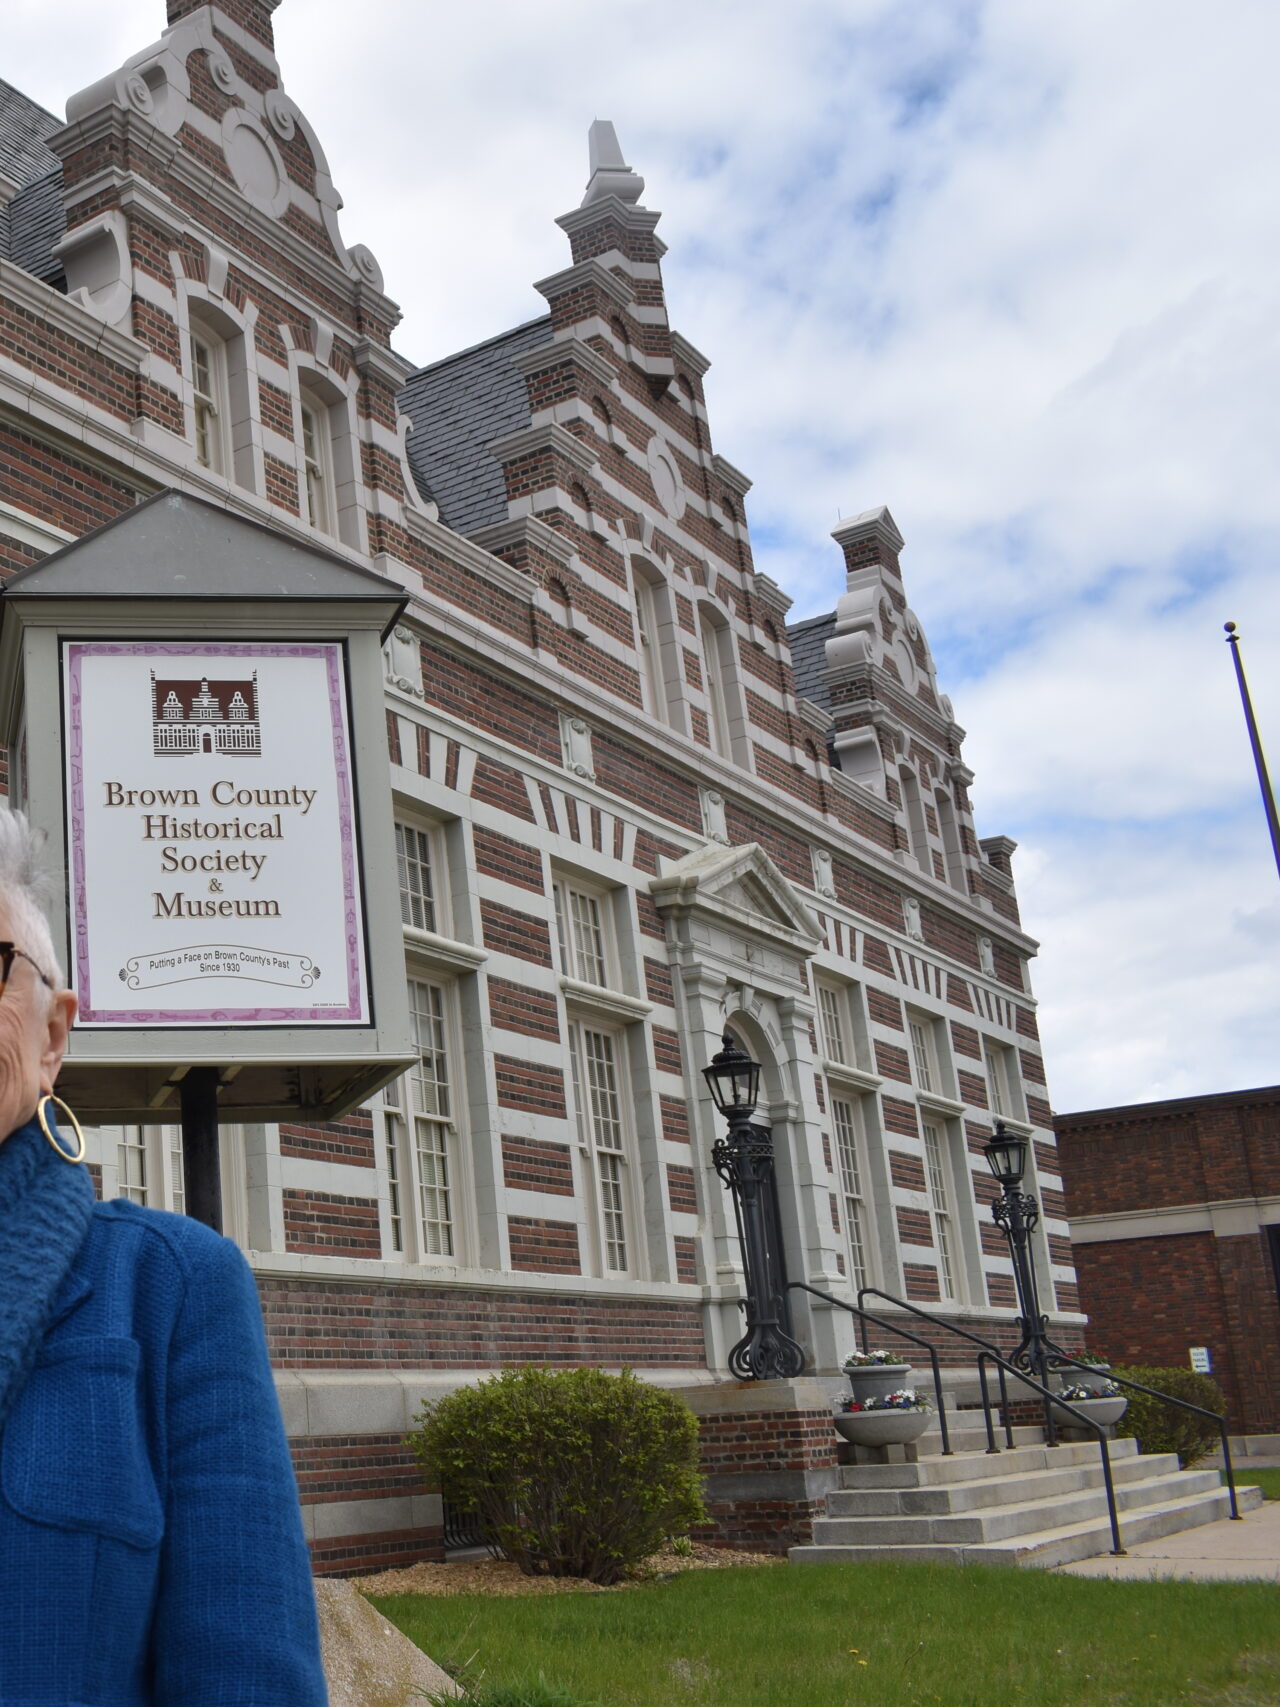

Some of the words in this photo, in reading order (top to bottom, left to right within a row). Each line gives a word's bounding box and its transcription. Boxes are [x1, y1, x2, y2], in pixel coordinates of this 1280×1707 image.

[102, 781, 200, 808] Brown
[210, 780, 318, 816] County
[142, 813, 284, 841] Historical
[161, 846, 268, 881] Society
[208, 877, 224, 893] &
[152, 892, 282, 919] Museum
[149, 957, 176, 970] Putting
[183, 953, 202, 963] Face
[203, 952, 213, 960] on
[214, 950, 238, 960] Brown
[239, 952, 271, 966] County's
[272, 957, 290, 969] Past
[199, 962, 221, 973] Since
[222, 963, 240, 973] 1930
